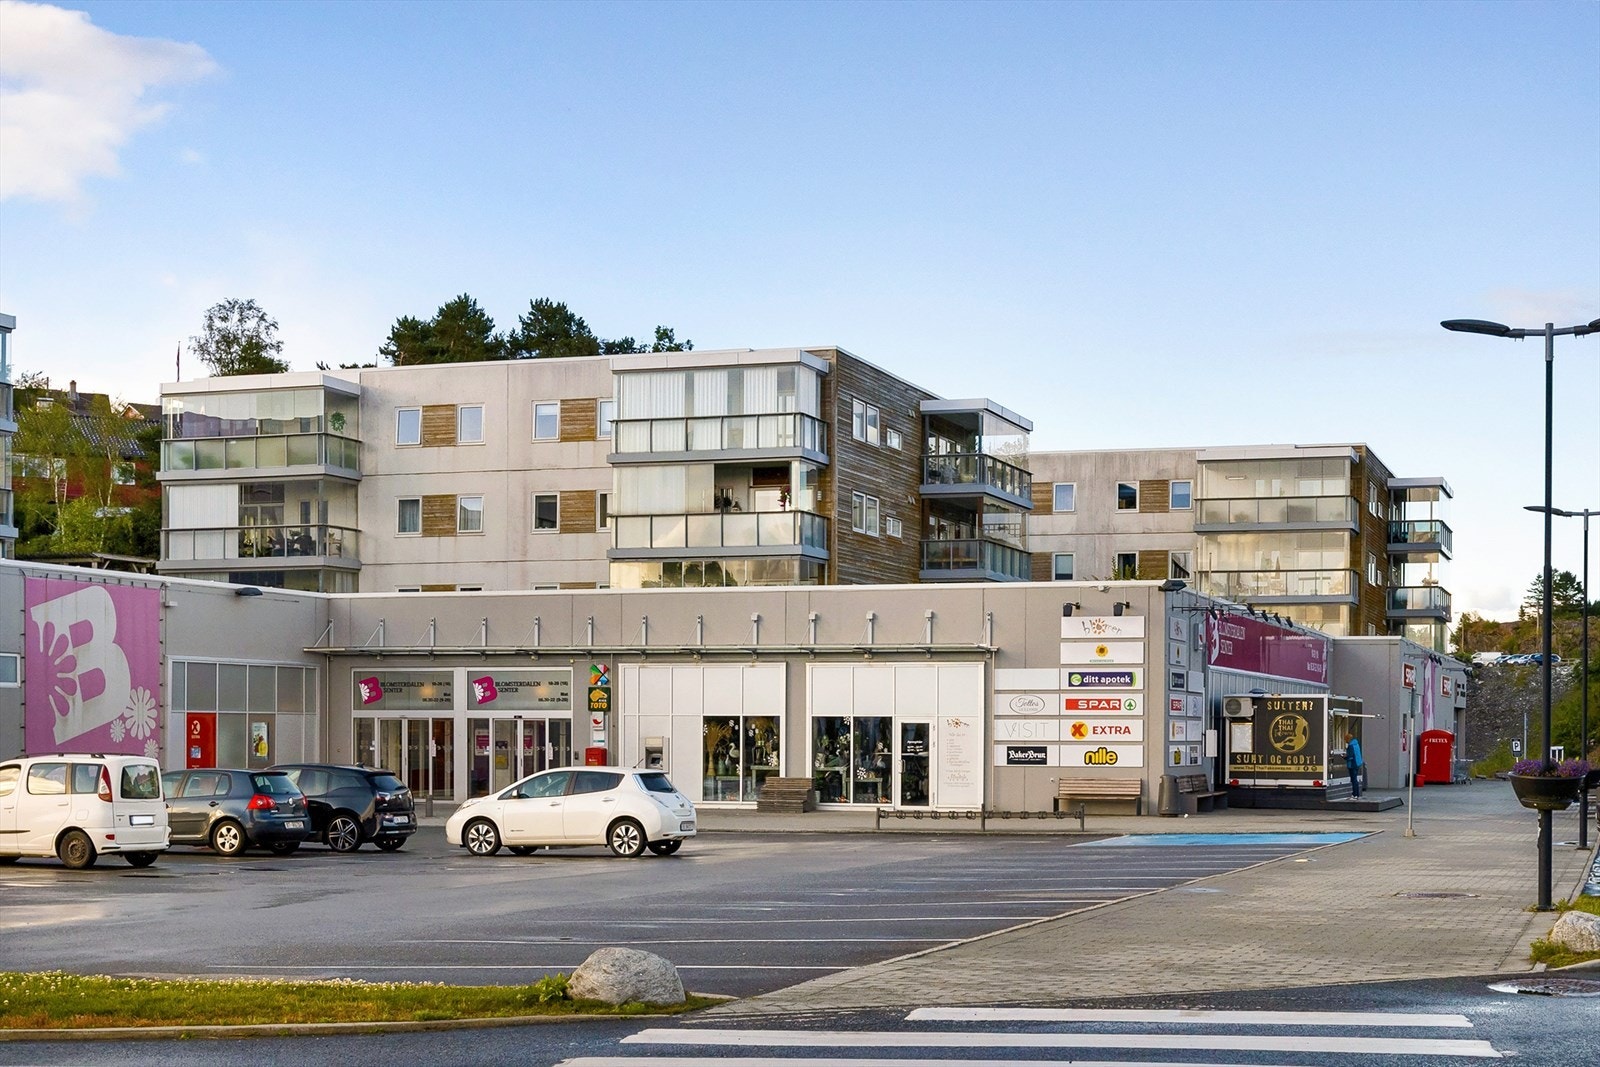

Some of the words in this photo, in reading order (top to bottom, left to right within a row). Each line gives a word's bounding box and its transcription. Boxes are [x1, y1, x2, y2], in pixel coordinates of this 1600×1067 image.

[1083, 675, 1099, 683] ditt
[1100, 675, 1131, 685] apotek
[1078, 700, 1120, 709] SPAR
[1267, 700, 1314, 711] SULTEN?
[1004, 722, 1049, 738] VISIT
[1092, 726, 1131, 735] EXTRA
[1085, 747, 1118, 764] nille
[1236, 754, 1264, 764] SUNT
[1270, 755, 1282, 764] OG
[1286, 754, 1316, 764] GODT!
